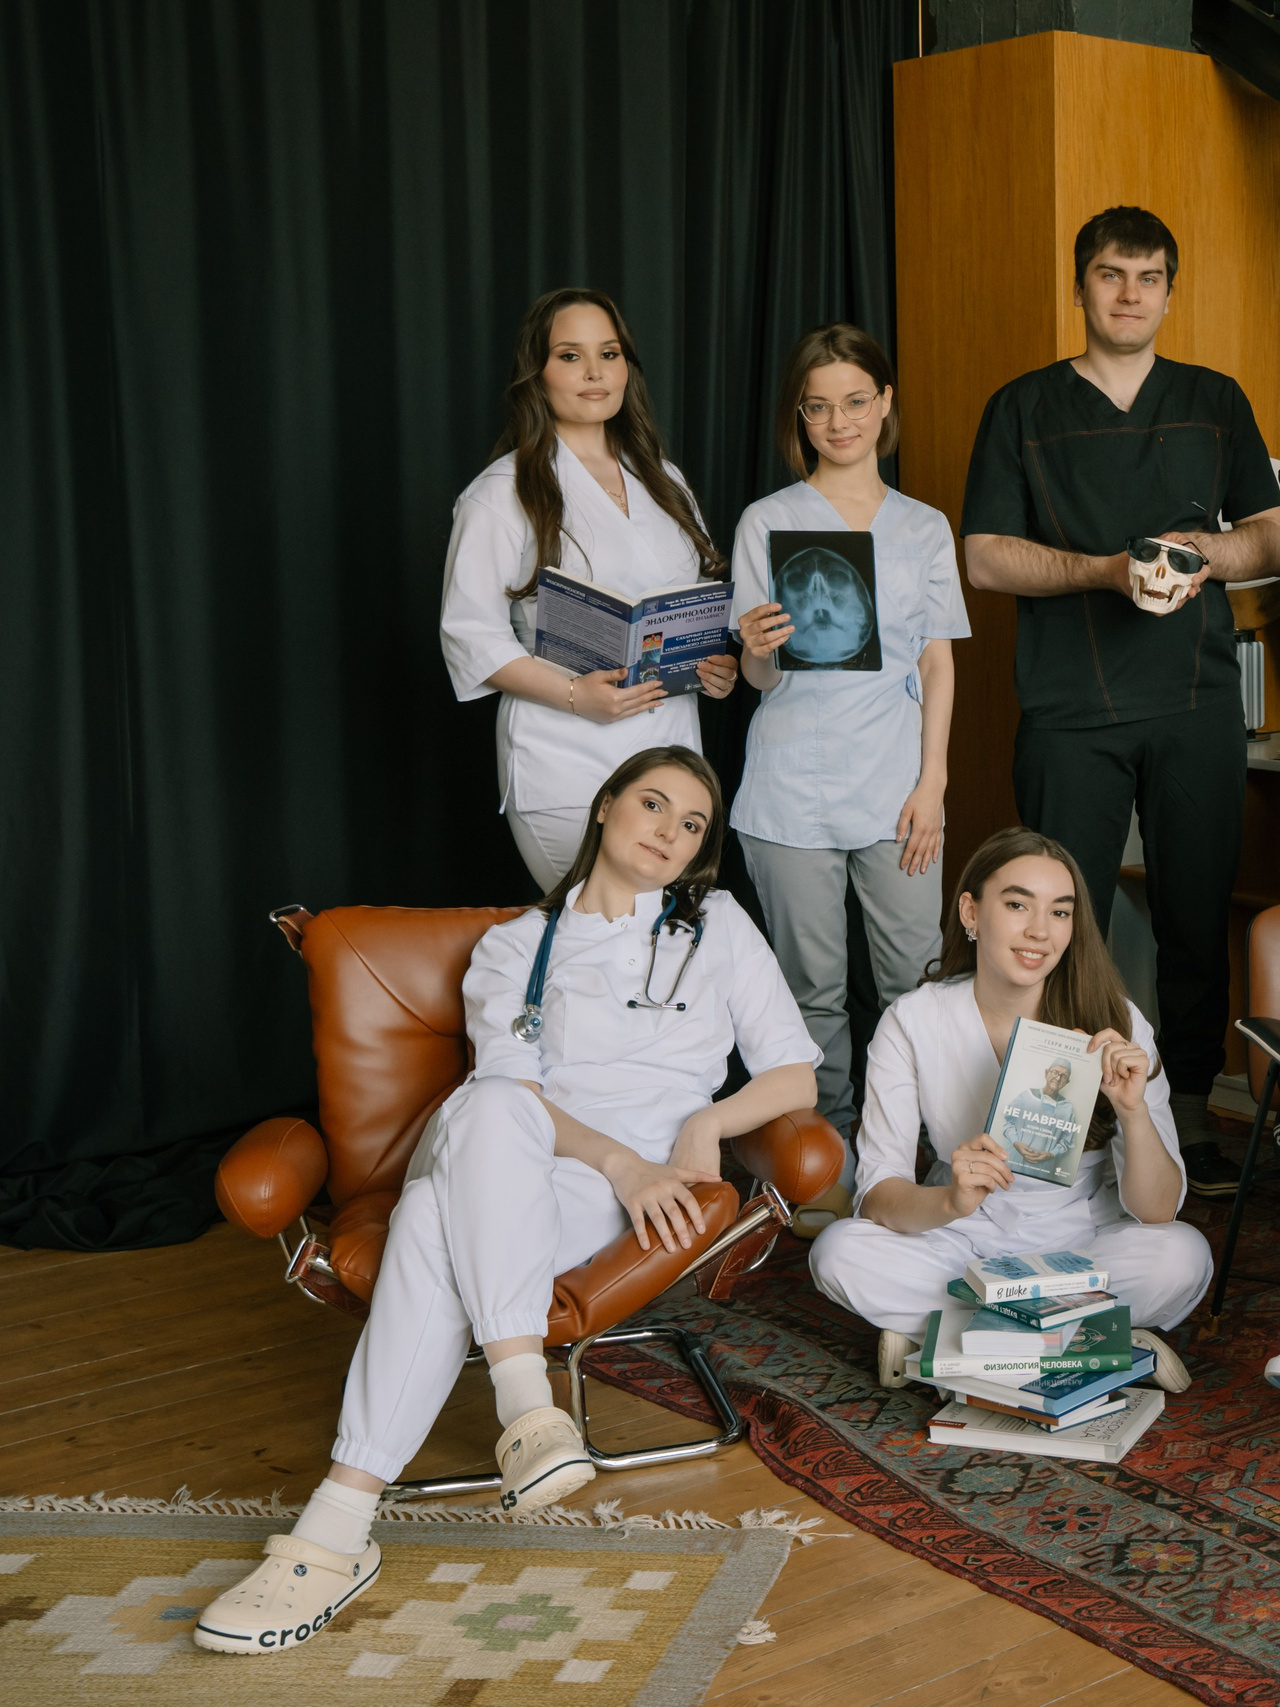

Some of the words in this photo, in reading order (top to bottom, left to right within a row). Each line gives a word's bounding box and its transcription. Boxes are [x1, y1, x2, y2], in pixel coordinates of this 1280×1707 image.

[644, 604, 726, 627] ЭНДОКРИНОЛОГИЯ
[1003, 1105, 1021, 1118] НЕ
[1022, 1110, 1082, 1134] НАВРЕДИ
[983, 1361, 1040, 1372] ФИЗИОЛОГИЯ
[1040, 1359, 1083, 1369] ЧЕЛОВЕКА
[1080, 1411, 1117, 1439] ОЕЗДА
[258, 1605, 333, 1648] crocs
